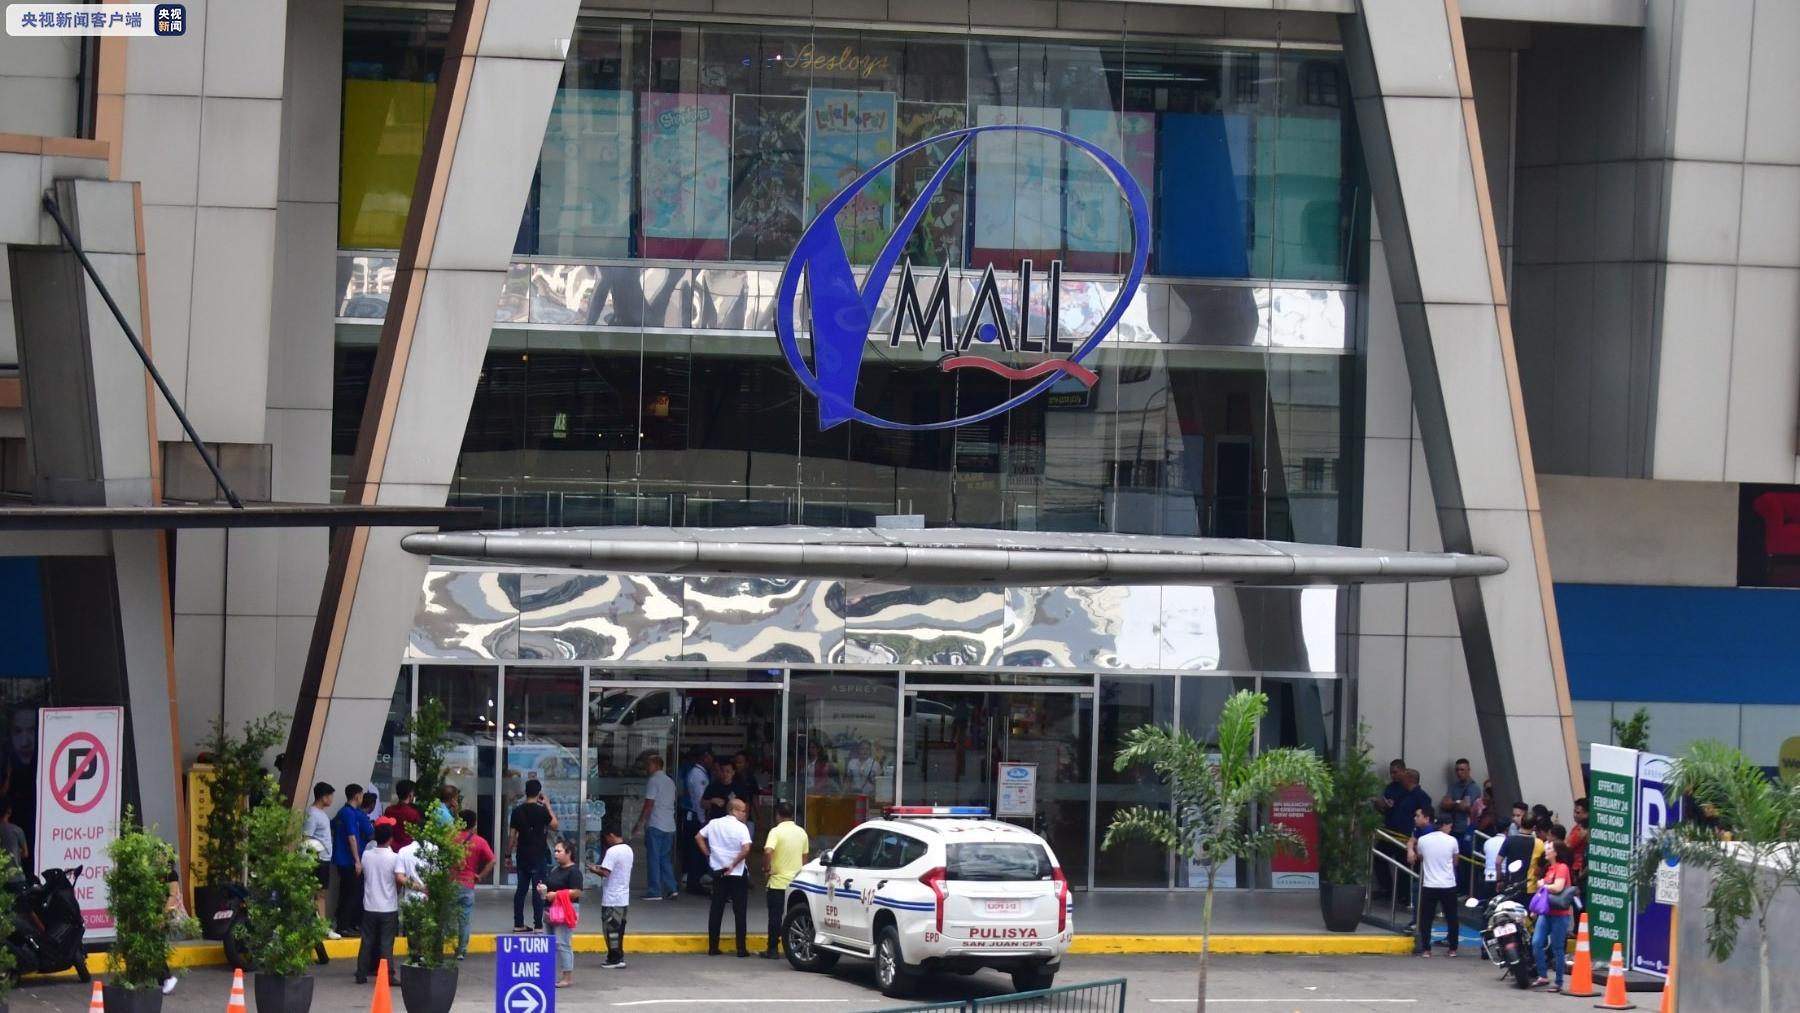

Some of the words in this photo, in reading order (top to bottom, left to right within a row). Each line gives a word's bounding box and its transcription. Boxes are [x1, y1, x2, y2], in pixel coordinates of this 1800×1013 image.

[889, 256, 1074, 353] MALL
[1598, 780, 1625, 794] EFFECTIVE
[1593, 795, 1620, 811] FEBRUARY
[1597, 812, 1608, 825] THIS
[1608, 815, 1624, 827] ROAD
[52, 826, 104, 840] PICK-UP
[1591, 828, 1608, 841] GOING
[1608, 831, 1615, 842] TO
[1615, 832, 1629, 845] CLUB
[64, 847, 91, 860] AND
[1600, 862, 1608, 873] BE
[825, 905, 838, 917] EPD
[1599, 910, 1615, 923] ROAD
[925, 932, 939, 943] EPD
[969, 928, 1037, 938] PULISYA
[511, 962, 540, 977] LANE
